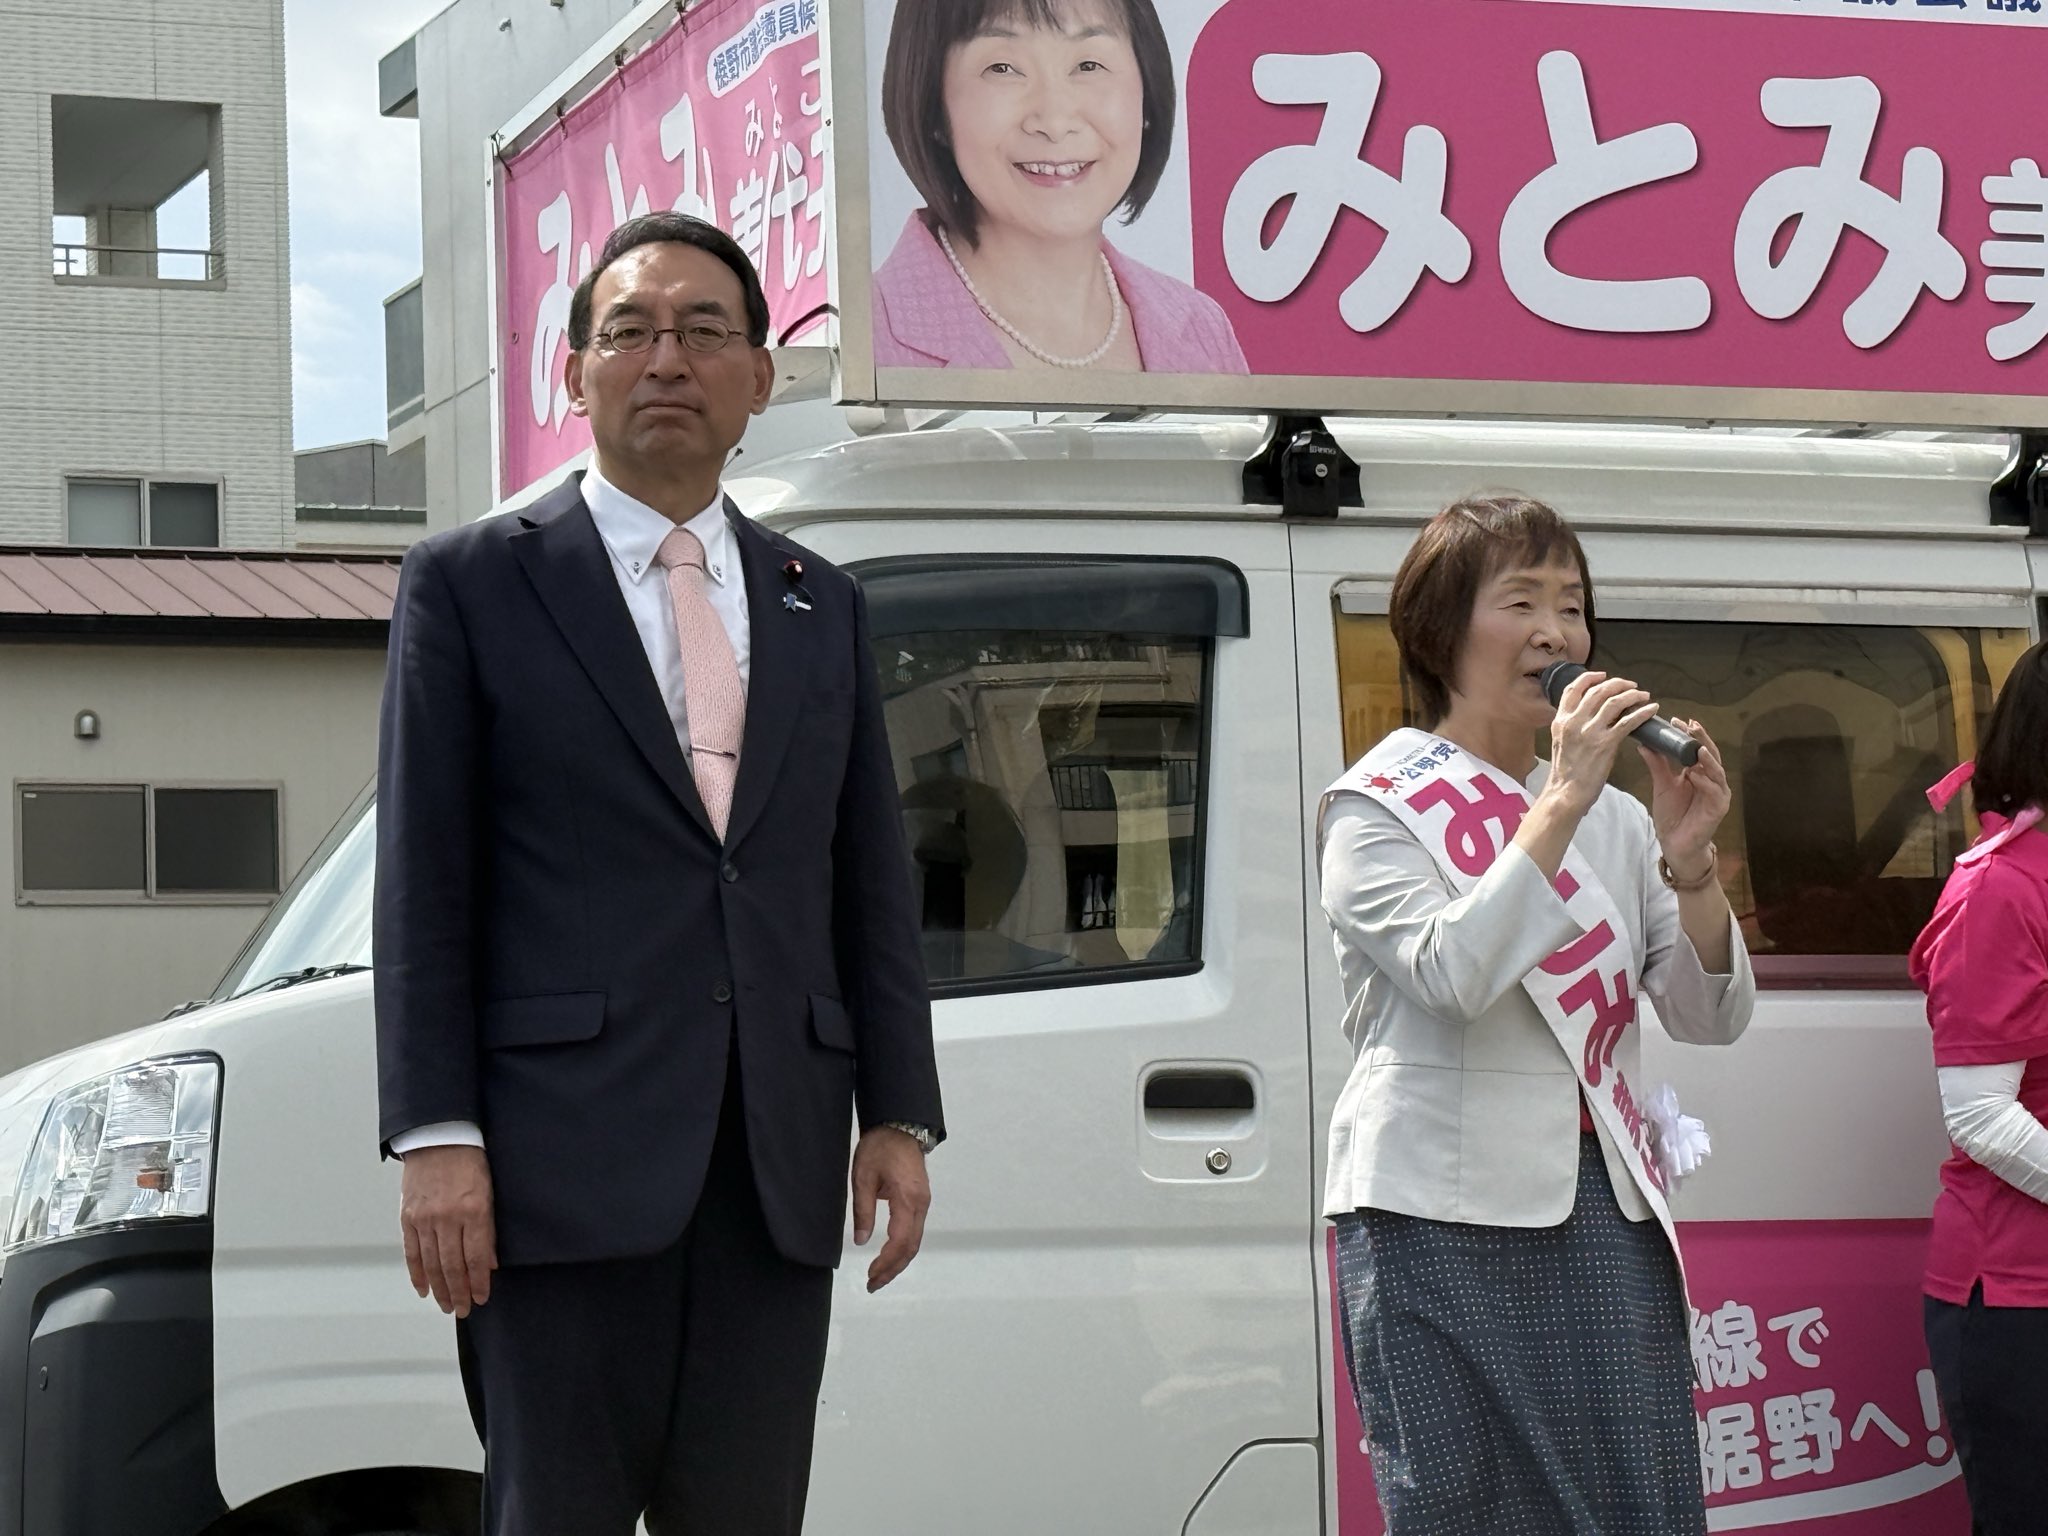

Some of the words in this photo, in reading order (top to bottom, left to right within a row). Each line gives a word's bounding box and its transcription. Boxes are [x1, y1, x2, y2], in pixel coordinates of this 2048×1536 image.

[1399, 743, 1460, 780] 公明党
[1689, 1300, 1829, 1392] 線で
